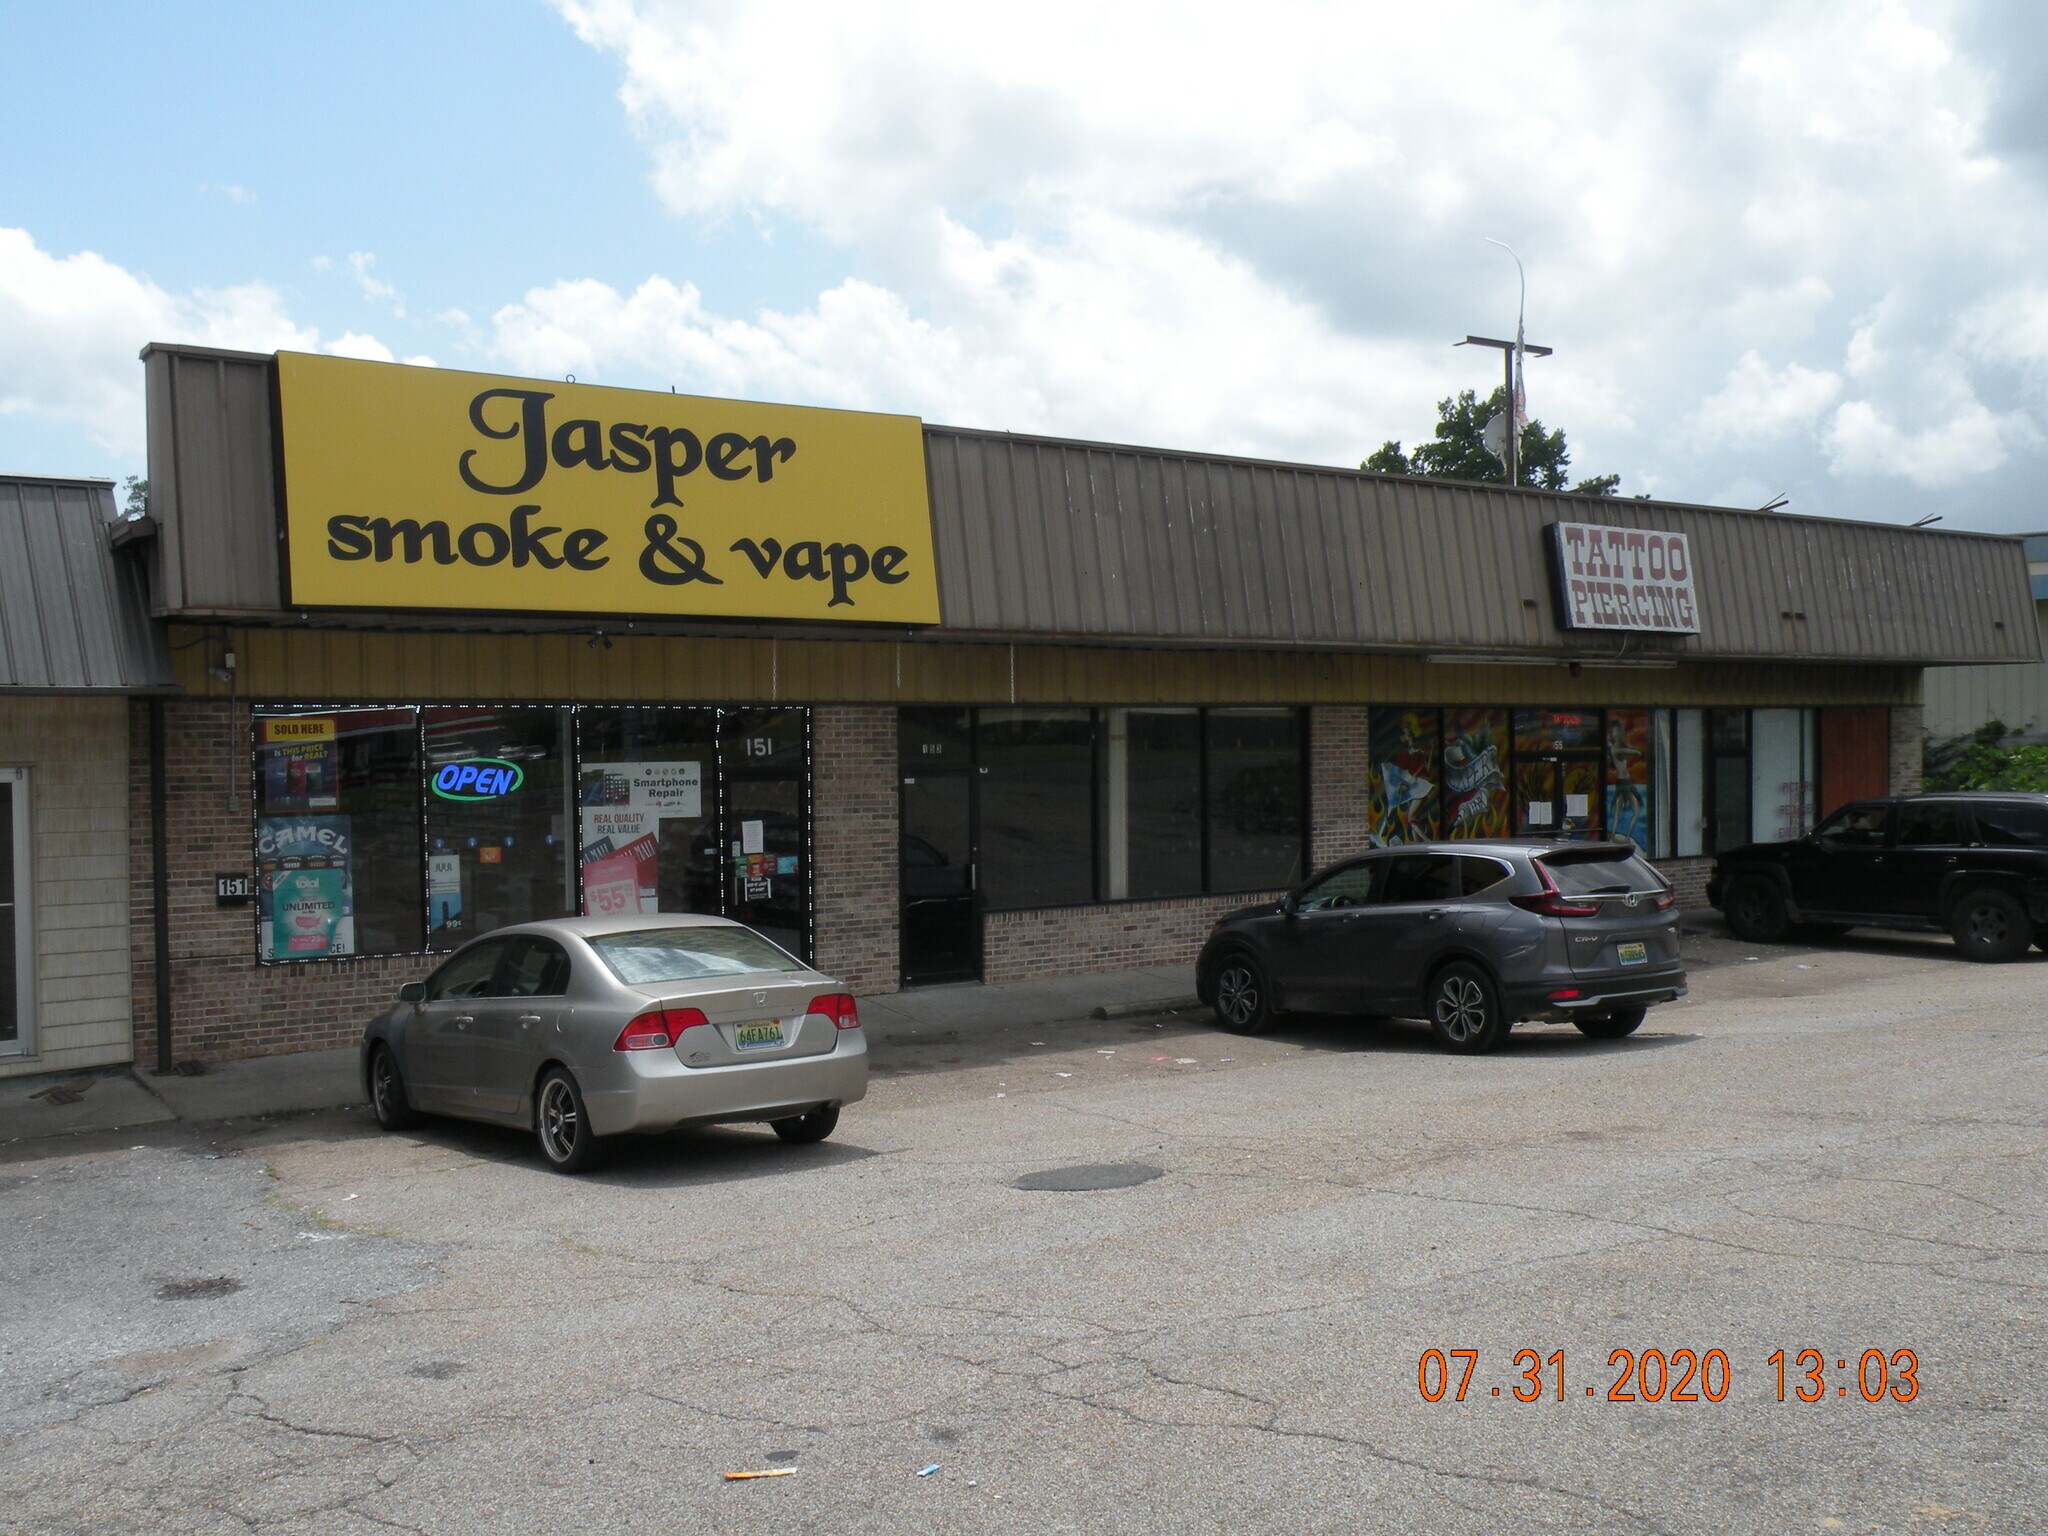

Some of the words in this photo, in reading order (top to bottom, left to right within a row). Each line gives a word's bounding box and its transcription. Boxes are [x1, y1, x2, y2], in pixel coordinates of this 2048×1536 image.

[458, 388, 796, 509] Jasper
[327, 505, 610, 571] smoke
[638, 514, 724, 586] &
[729, 537, 910, 609] vape
[1565, 527, 1688, 582] TATTOO
[1571, 579, 1695, 629] PIERCING
[273, 724, 299, 735] SOLD
[300, 723, 325, 734] HERE
[282, 746, 300, 756] THIS
[301, 743, 324, 754] PRICE
[746, 737, 772, 756] 151
[291, 754, 303, 763] for
[304, 750, 328, 760] REAL?
[437, 764, 514, 796] OPEN
[633, 778, 699, 788] Smartphone
[648, 788, 685, 799] Repair
[593, 813, 613, 824] REAL
[613, 812, 645, 824] QUALITY
[597, 824, 616, 835] REAL
[617, 823, 641, 834] VALUE
[258, 825, 348, 854] CAMEL
[221, 879, 246, 895] 151
[295, 876, 320, 889] total
[281, 901, 336, 912] UNLIMITED
